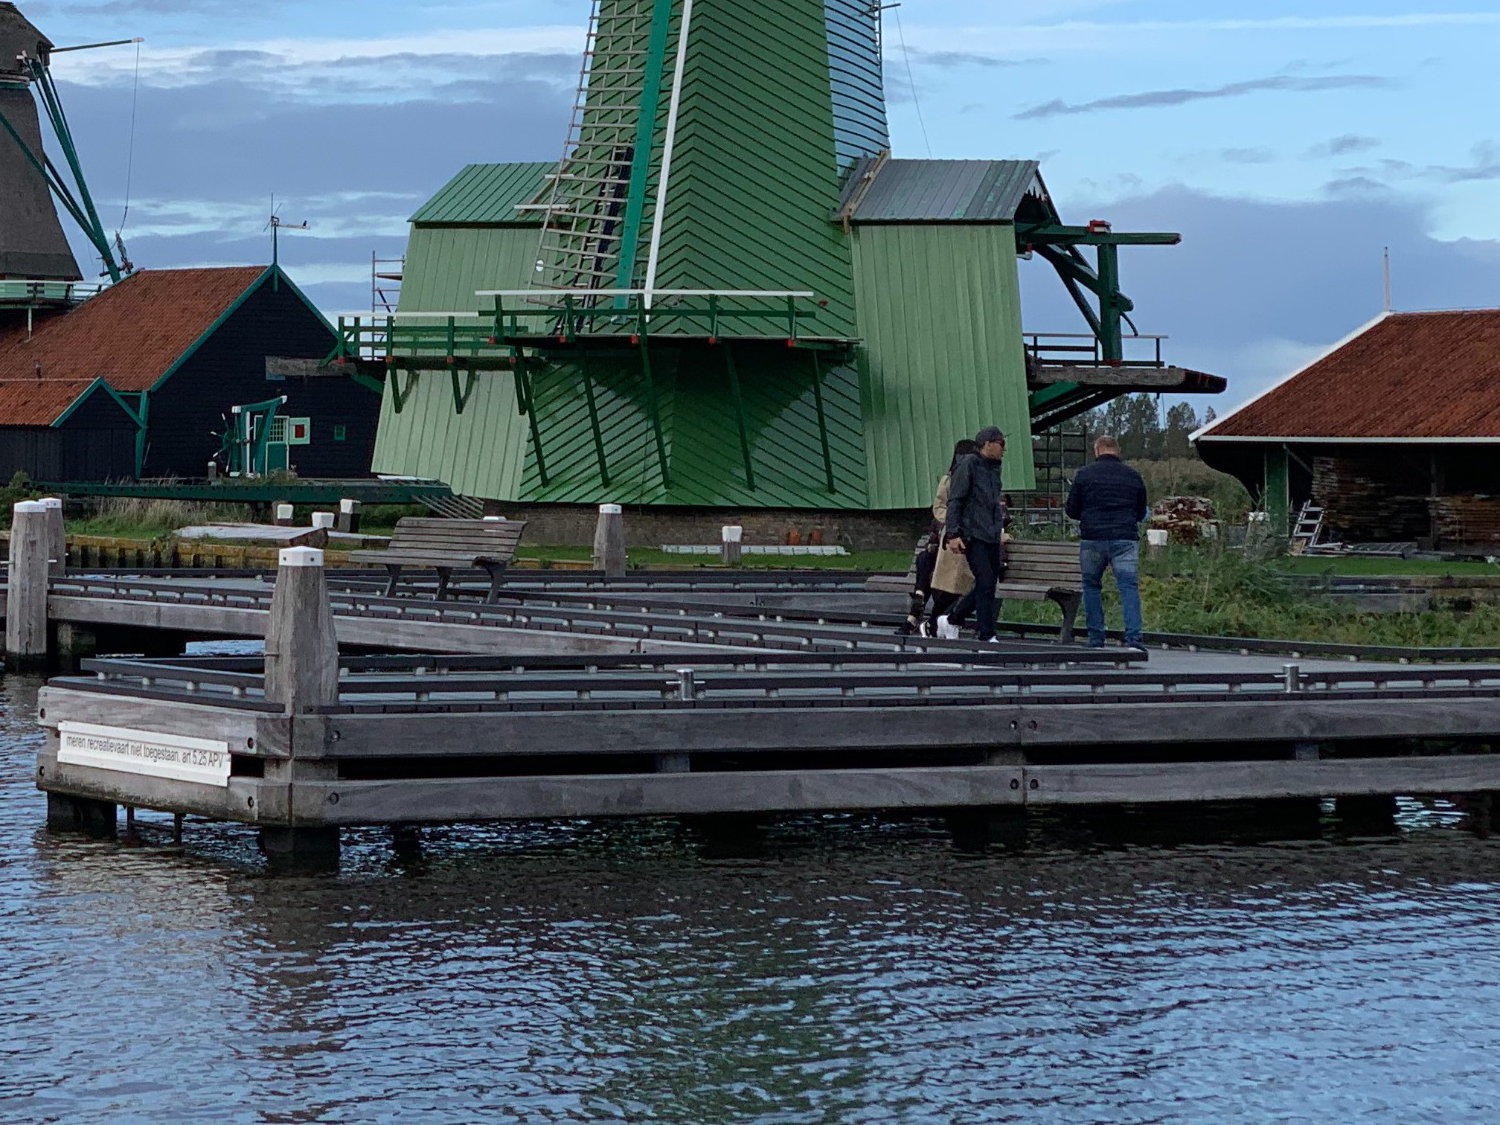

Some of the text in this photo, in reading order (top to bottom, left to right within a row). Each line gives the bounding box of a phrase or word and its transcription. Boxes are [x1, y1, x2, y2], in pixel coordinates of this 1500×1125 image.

[66, 736, 86, 748] meren
[87, 738, 130, 755] recreatievaart
[131, 742, 142, 757] niet
[182, 751, 191, 763] art
[207, 751, 223, 767] APV
